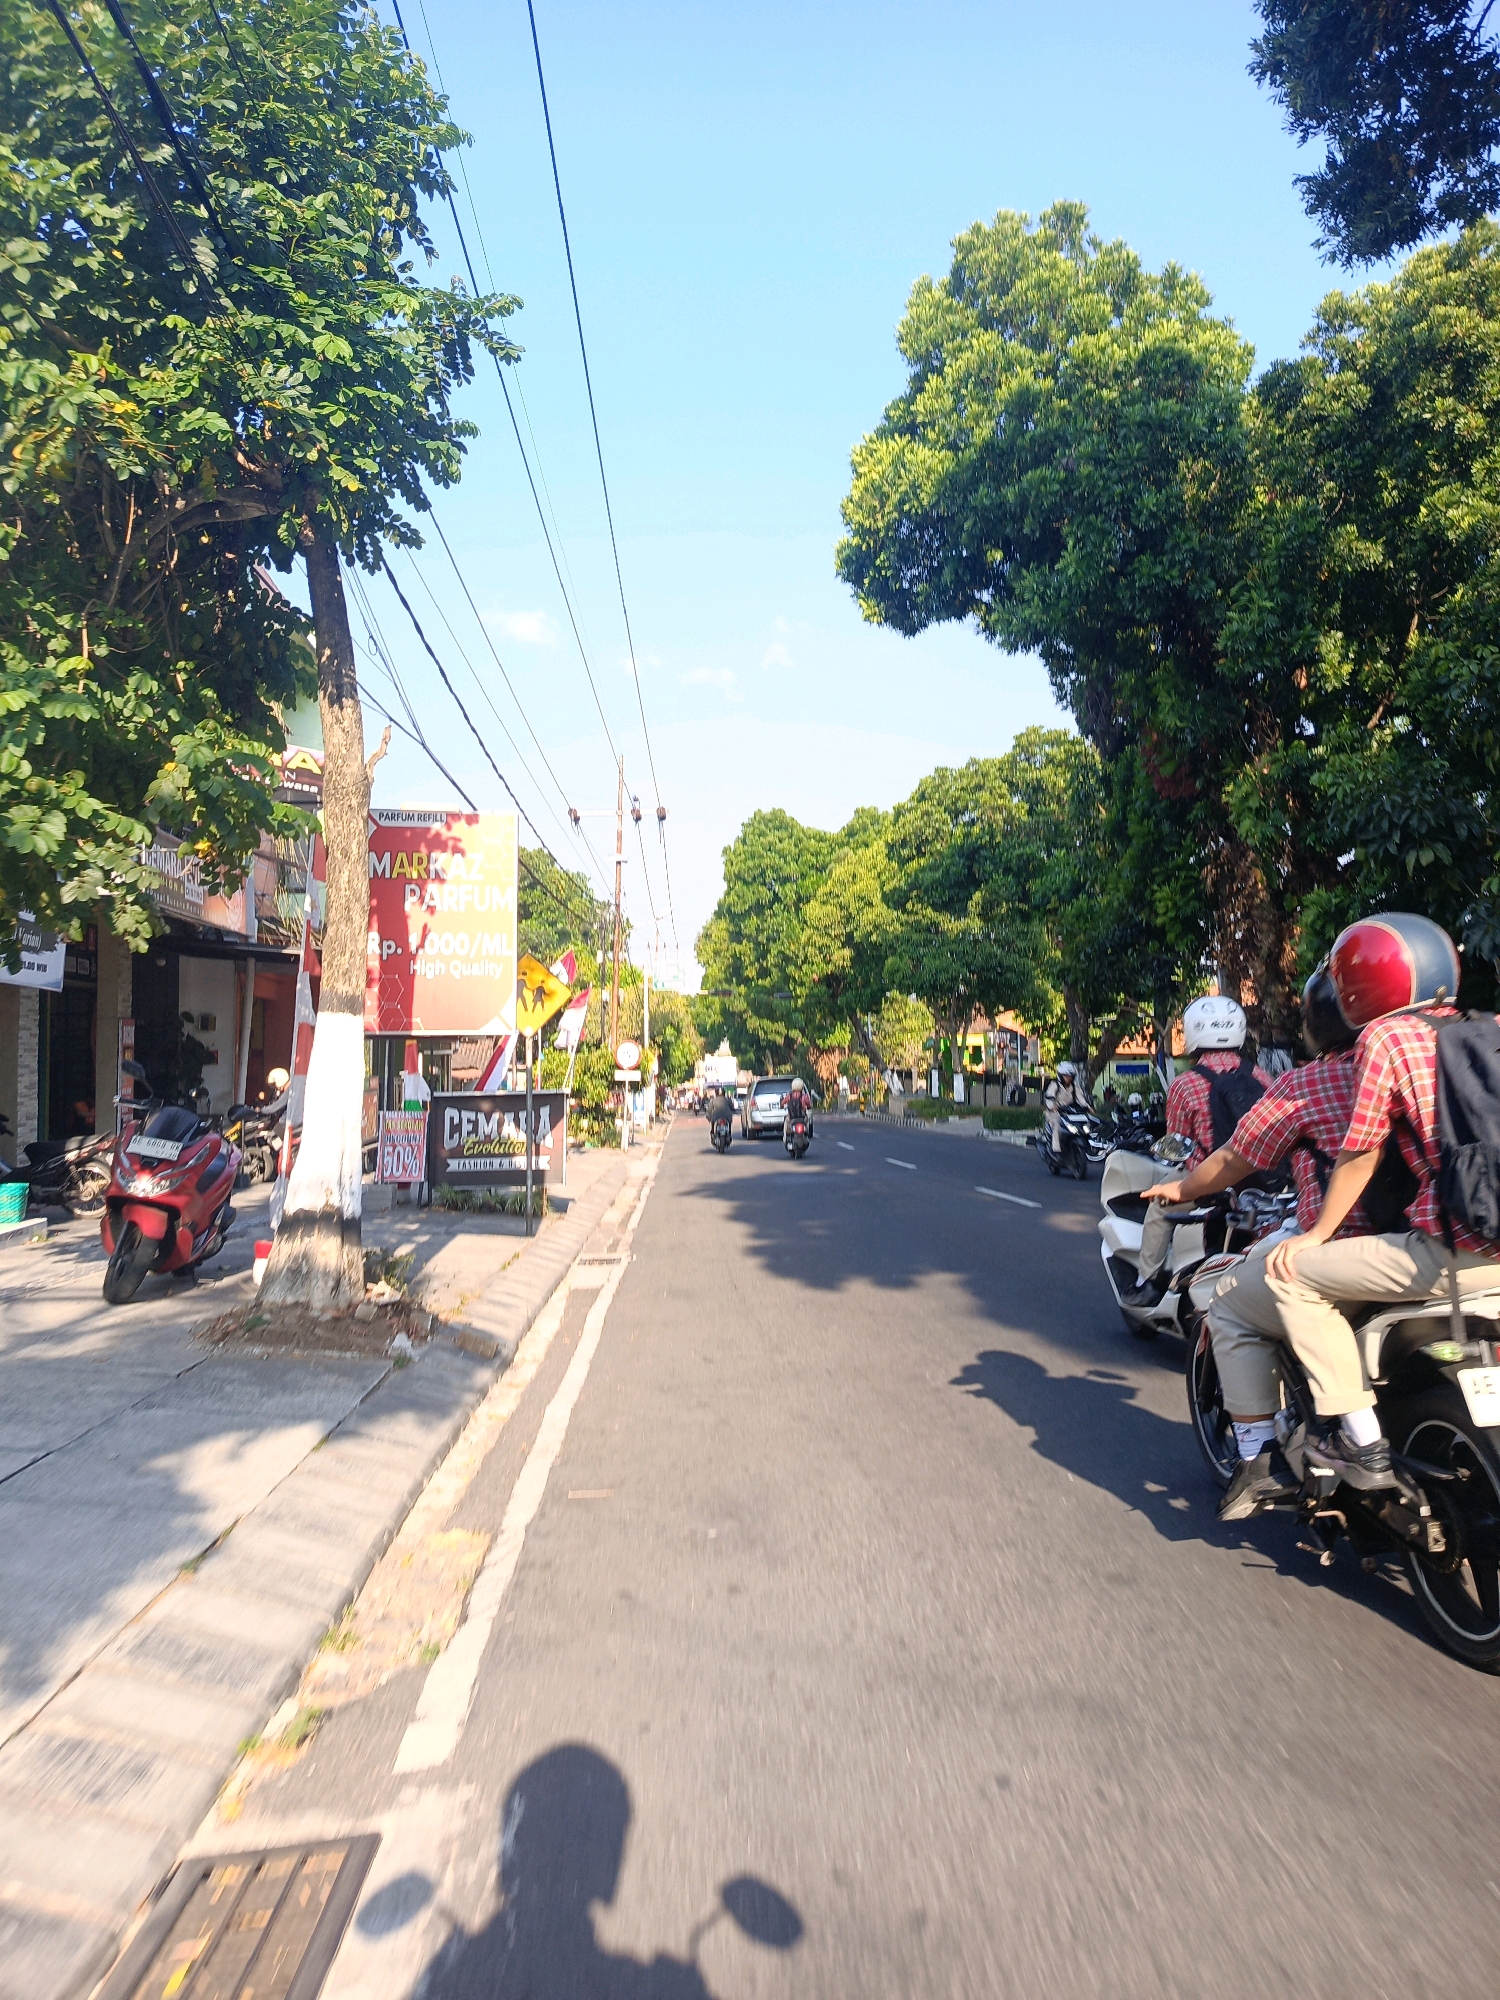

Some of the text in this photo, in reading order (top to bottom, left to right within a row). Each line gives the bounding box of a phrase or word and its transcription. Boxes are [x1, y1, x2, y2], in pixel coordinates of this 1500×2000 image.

[378, 812, 445, 823] PARFUM REFILL
[369, 851, 485, 881] MARKAZ
[404, 883, 514, 912] PARFUM
[367, 931, 514, 961] Rp. 1.000/ML
[409, 958, 504, 980] High Quality
[383, 1145, 420, 1178] 50%
[457, 1158, 494, 1171] FASHION
[498, 1157, 505, 1170] &
